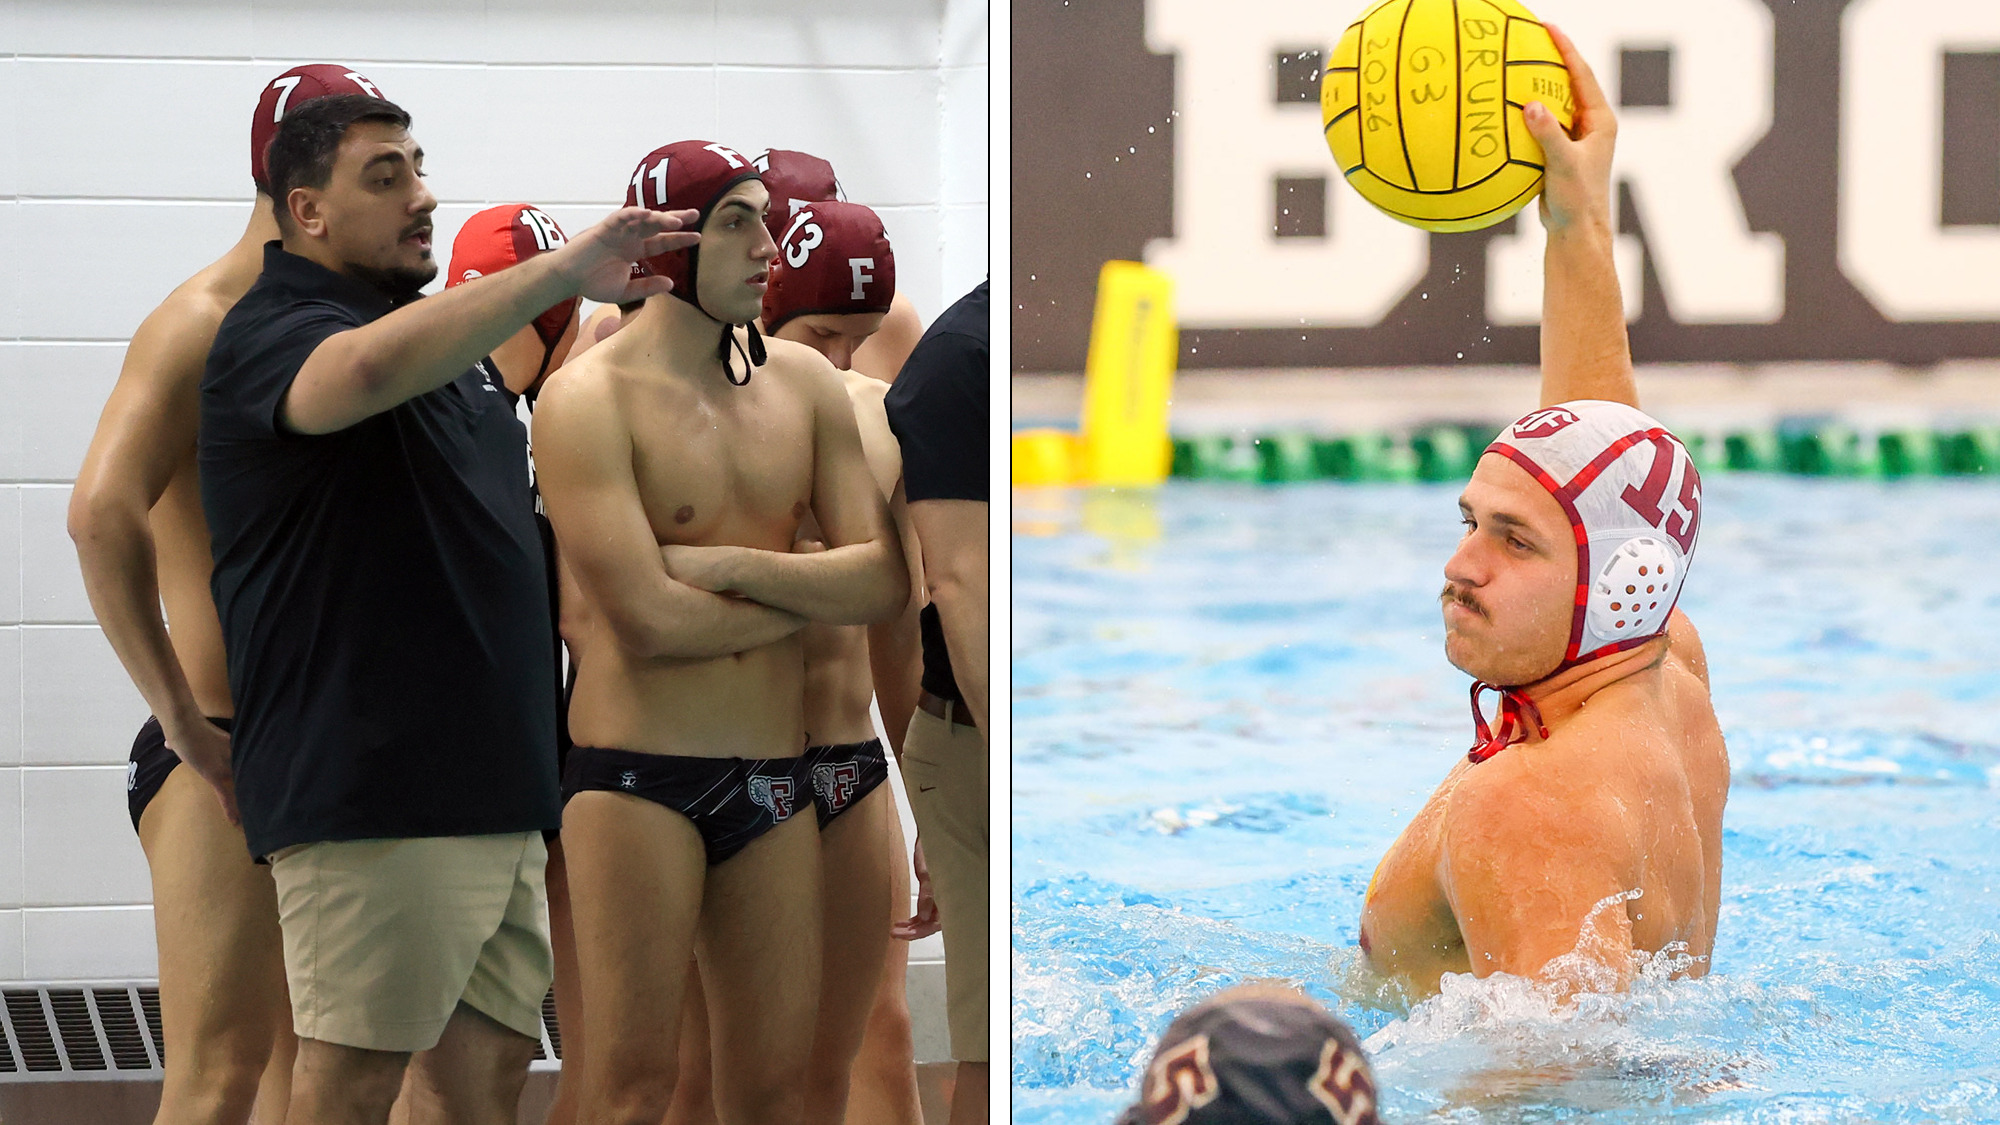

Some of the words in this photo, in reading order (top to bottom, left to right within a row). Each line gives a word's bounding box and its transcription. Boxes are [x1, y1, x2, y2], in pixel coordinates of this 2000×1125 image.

[272, 75, 302, 124] 7
[1362, 37, 1393, 133] 2026
[1463, 17, 1500, 159] BRUNO
[631, 157, 670, 209] 11
[703, 143, 745, 170] F
[781, 211, 824, 269] 13
[848, 257, 875, 300] F
[1620, 436, 1700, 555] 15
